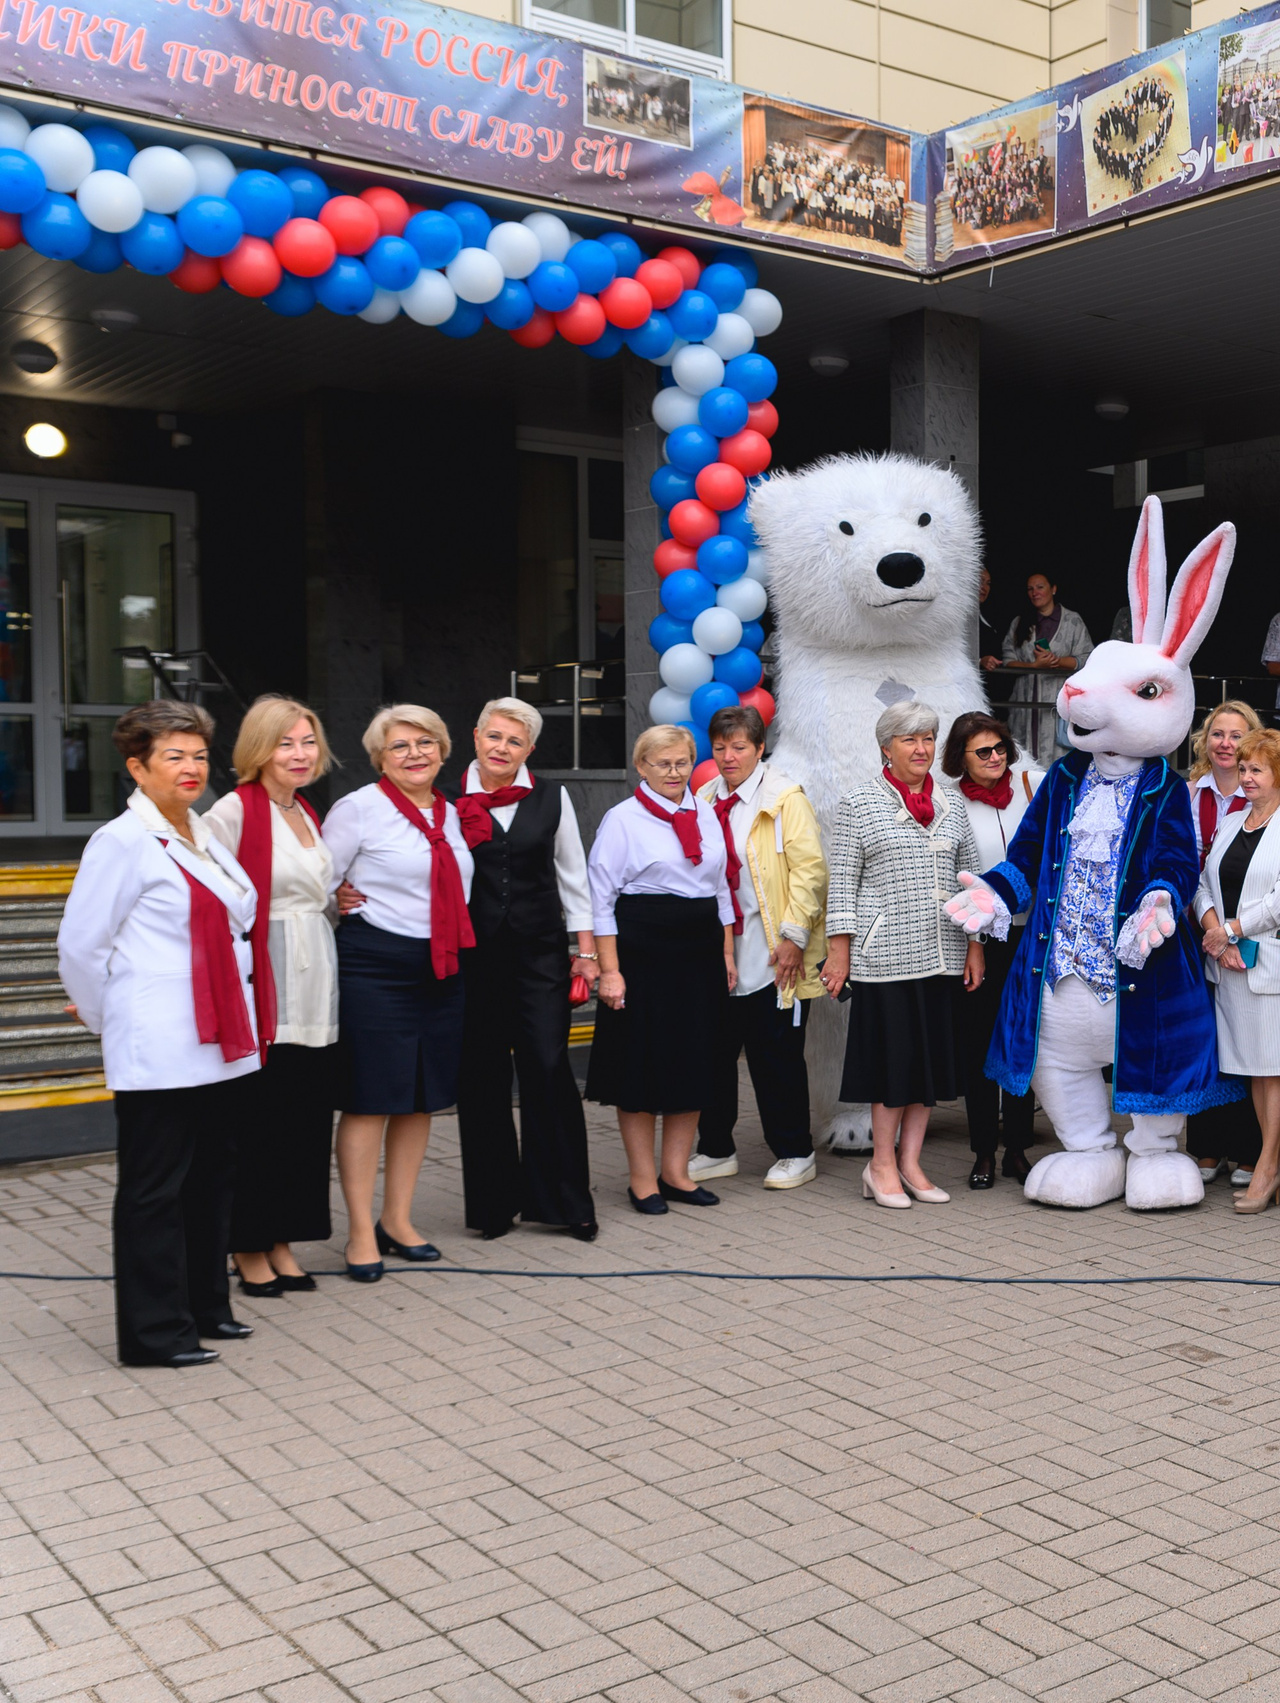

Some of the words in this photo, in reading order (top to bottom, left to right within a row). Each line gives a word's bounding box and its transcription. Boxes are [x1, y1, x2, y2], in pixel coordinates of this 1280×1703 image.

[162, 40, 420, 134] ПРИНОСЯТ
[428, 104, 565, 163] СЛАВУ
[571, 134, 633, 181] ЕЙ!
[375, 16, 569, 108] РОССИЯ,
